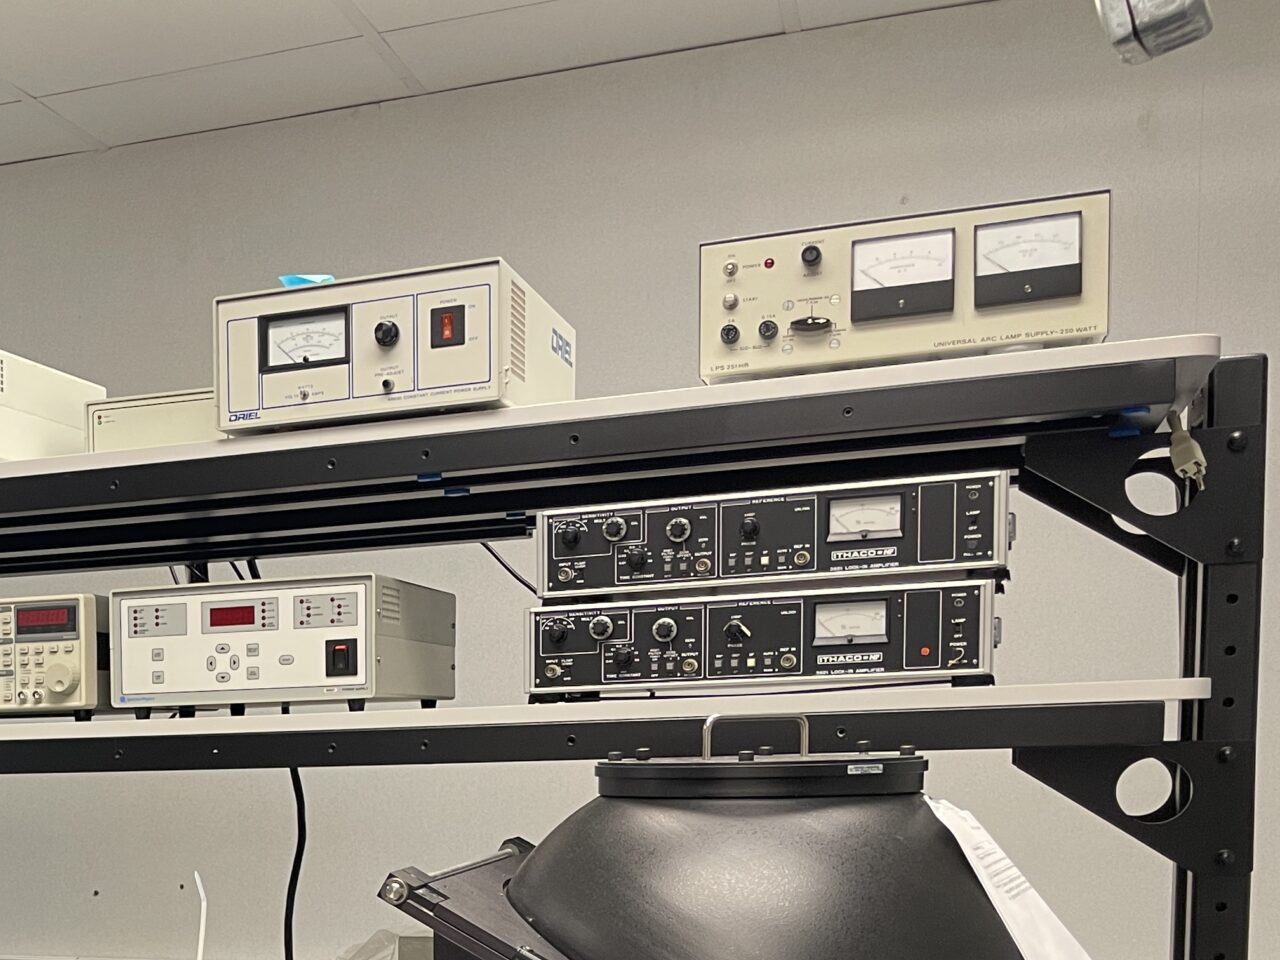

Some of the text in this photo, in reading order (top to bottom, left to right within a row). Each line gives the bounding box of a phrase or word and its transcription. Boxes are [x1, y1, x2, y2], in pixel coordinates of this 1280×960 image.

[933, 337, 977, 348] UNIVERSAL
[980, 335, 997, 343] ARC
[999, 333, 1022, 341] LAMP
[1075, 325, 1098, 333] WATT
[819, 655, 863, 663] ITHACO
